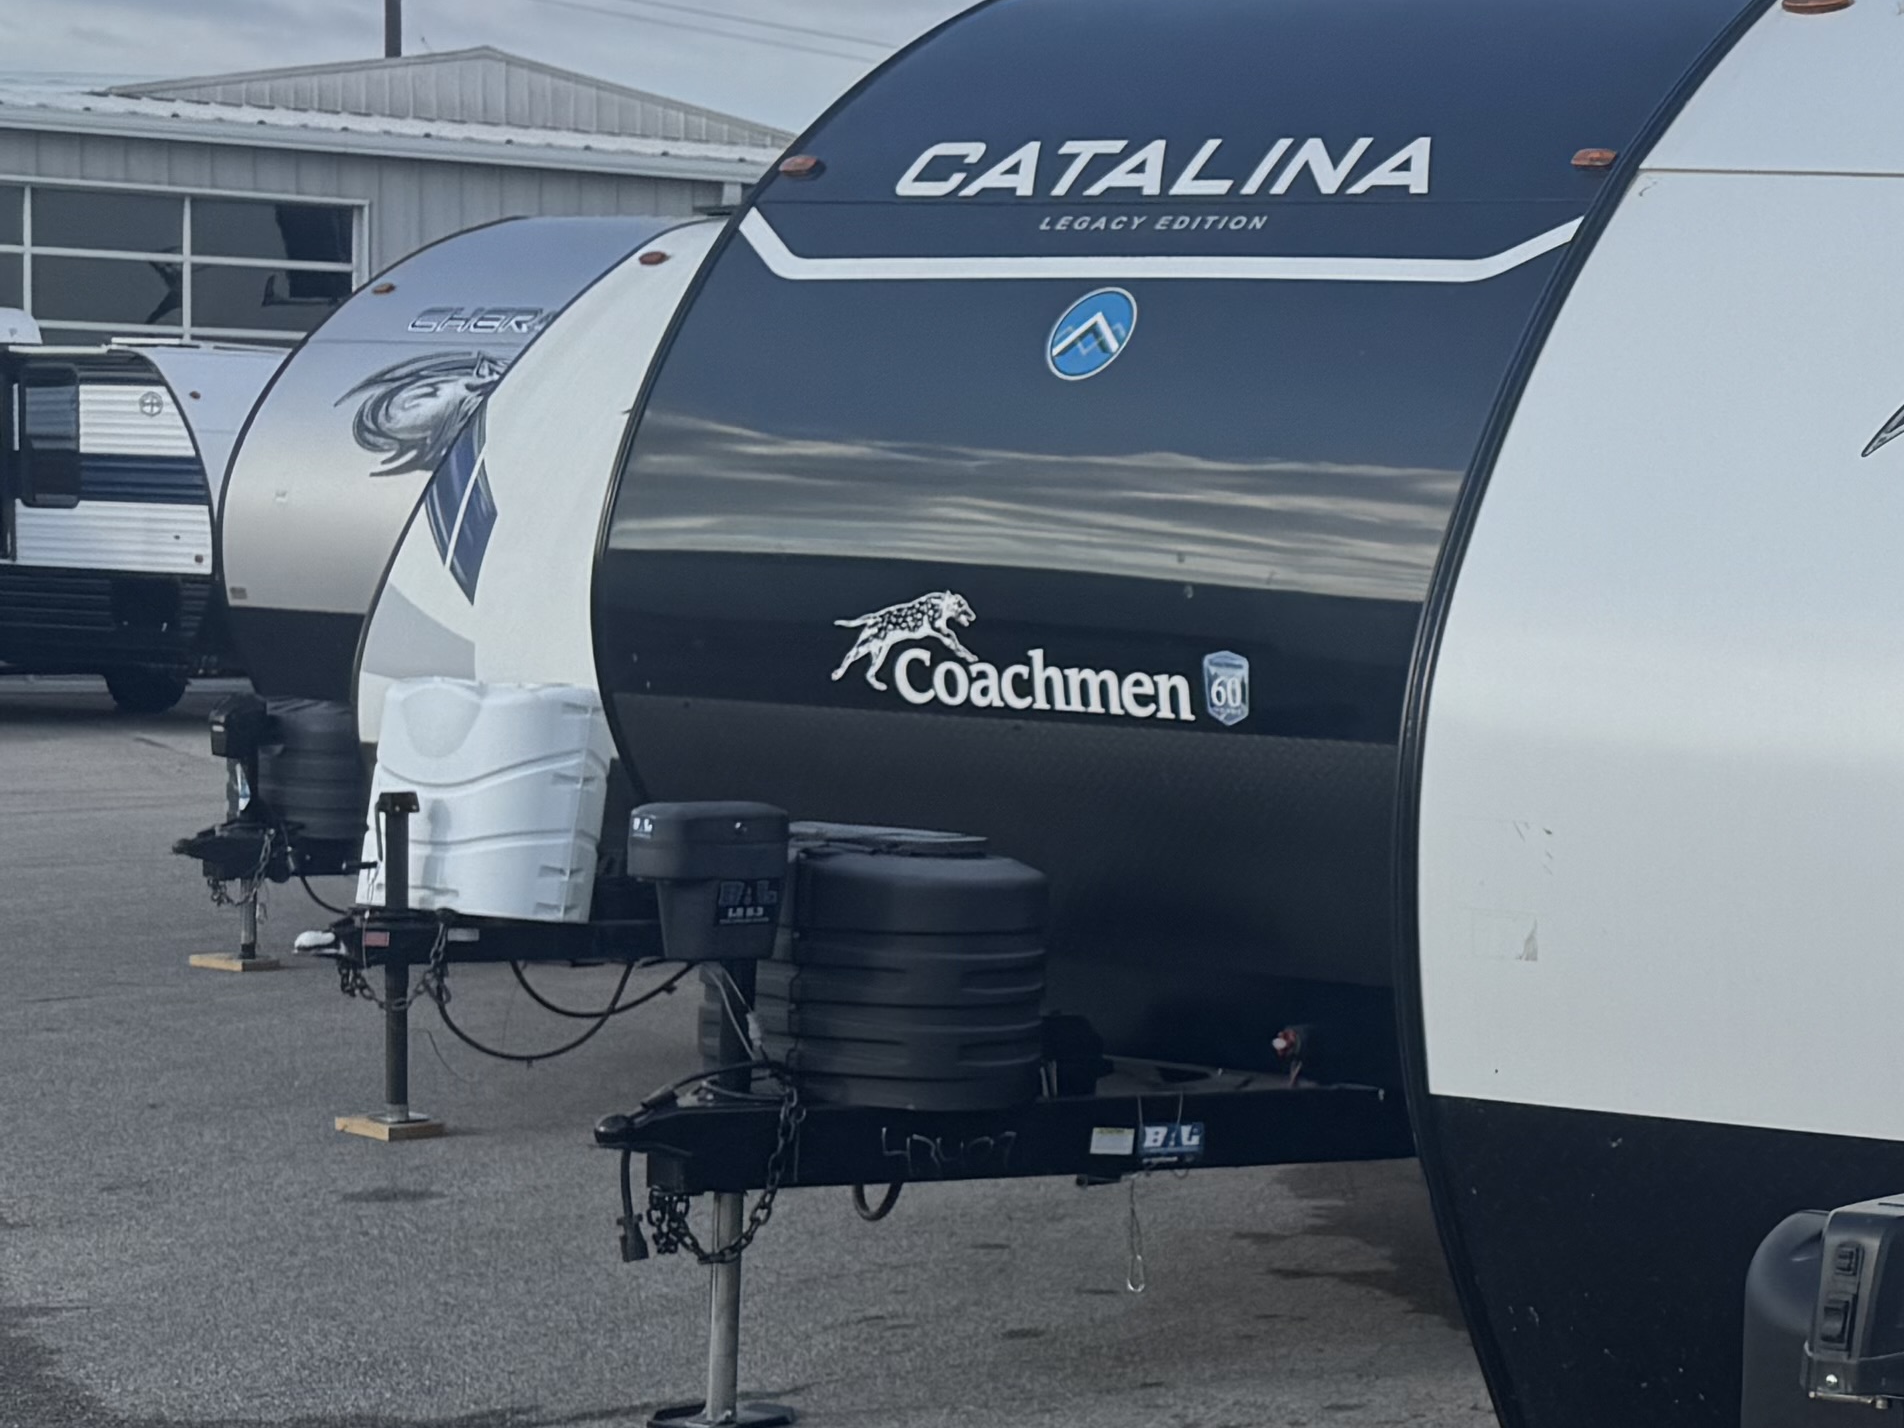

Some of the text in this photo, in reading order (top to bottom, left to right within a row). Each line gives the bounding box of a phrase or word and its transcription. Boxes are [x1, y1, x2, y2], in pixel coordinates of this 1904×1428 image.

[895, 136, 1432, 197] CATALINA
[1038, 215, 1268, 232] LEGACY EDITION
[894, 648, 1196, 721] Coachmen
[1211, 676, 1242, 707] 60
